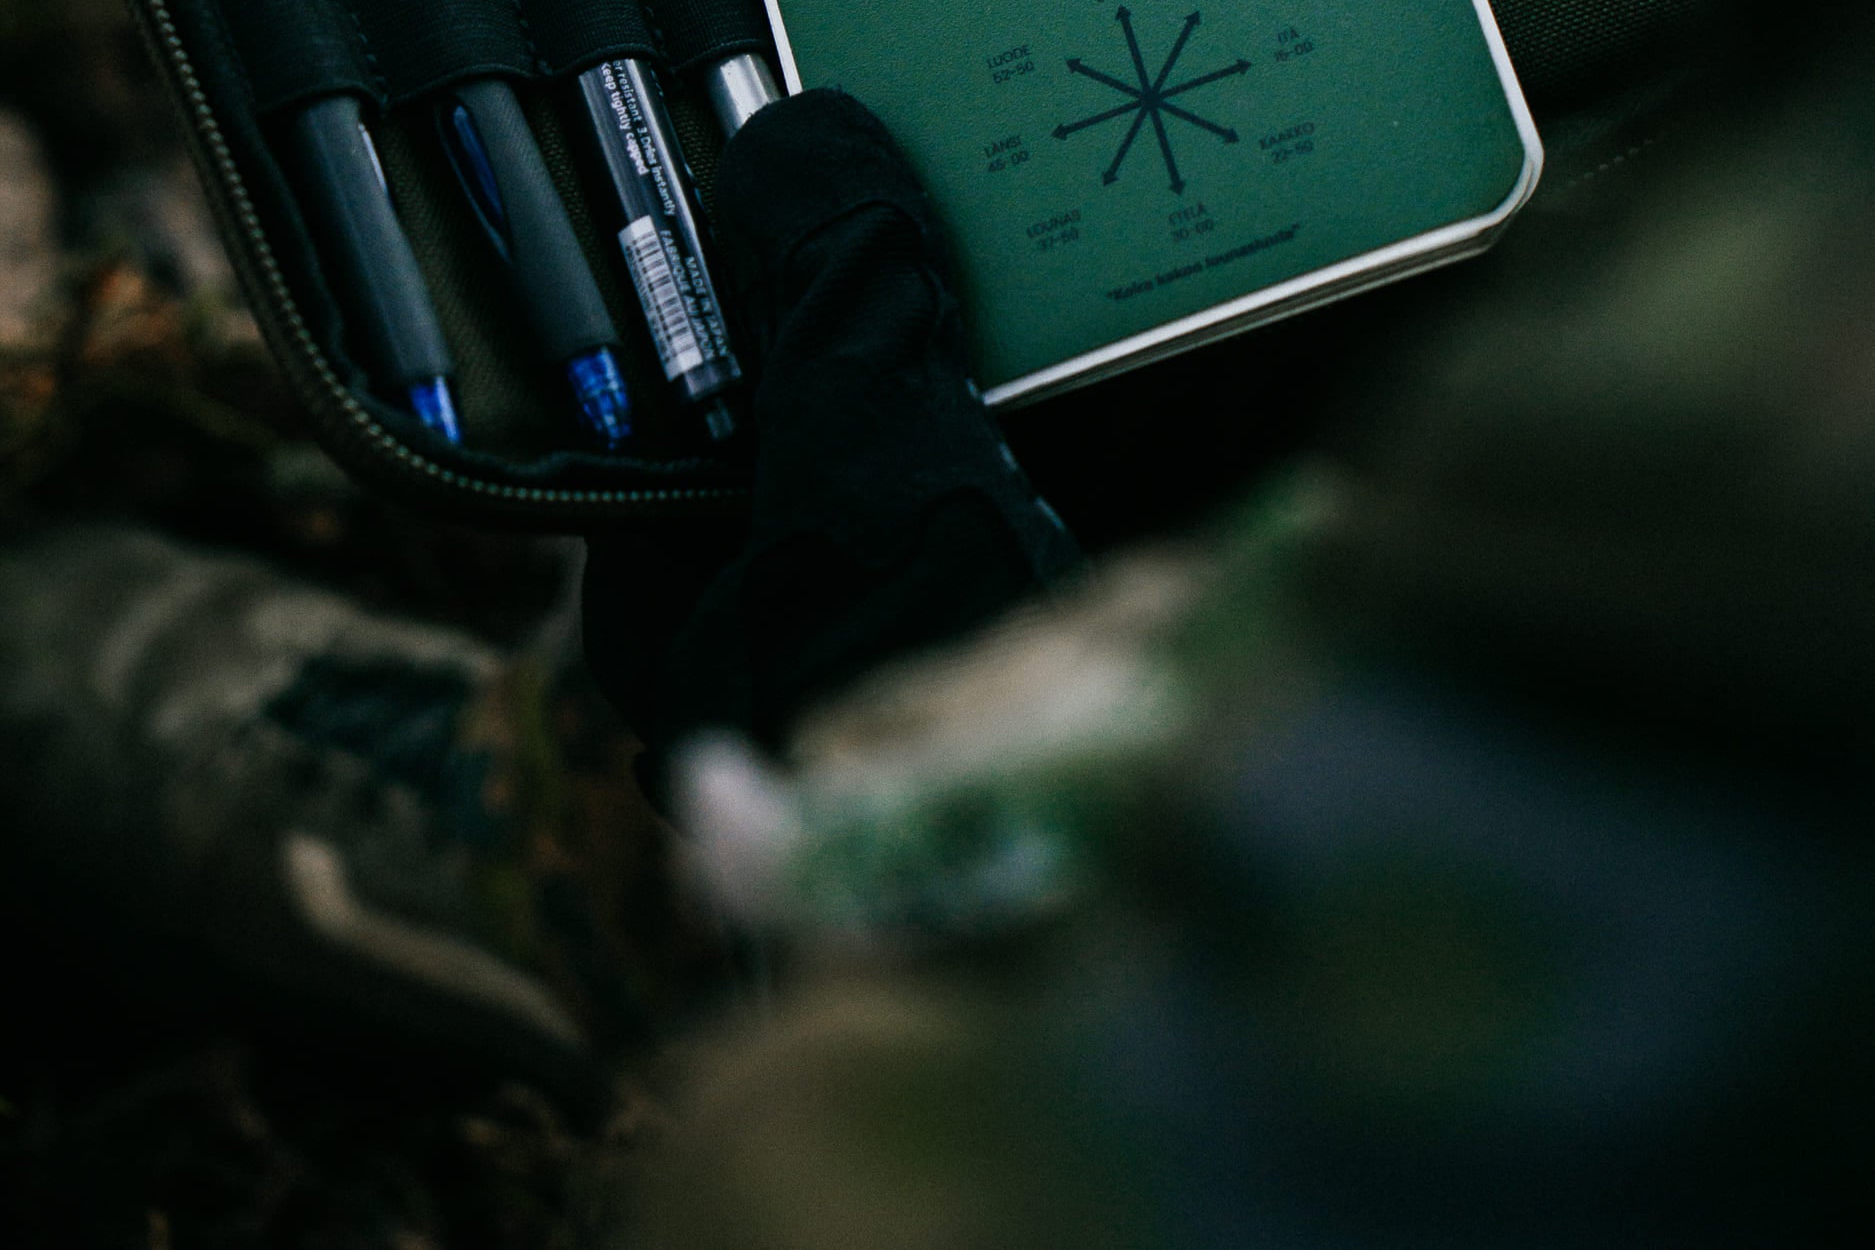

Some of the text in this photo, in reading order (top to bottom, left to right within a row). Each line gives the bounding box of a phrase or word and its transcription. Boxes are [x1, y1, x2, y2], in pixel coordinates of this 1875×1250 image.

[599, 61, 650, 176] Keep tightly capped
[615, 71, 643, 122] resistant
[649, 164, 677, 217] instantly
